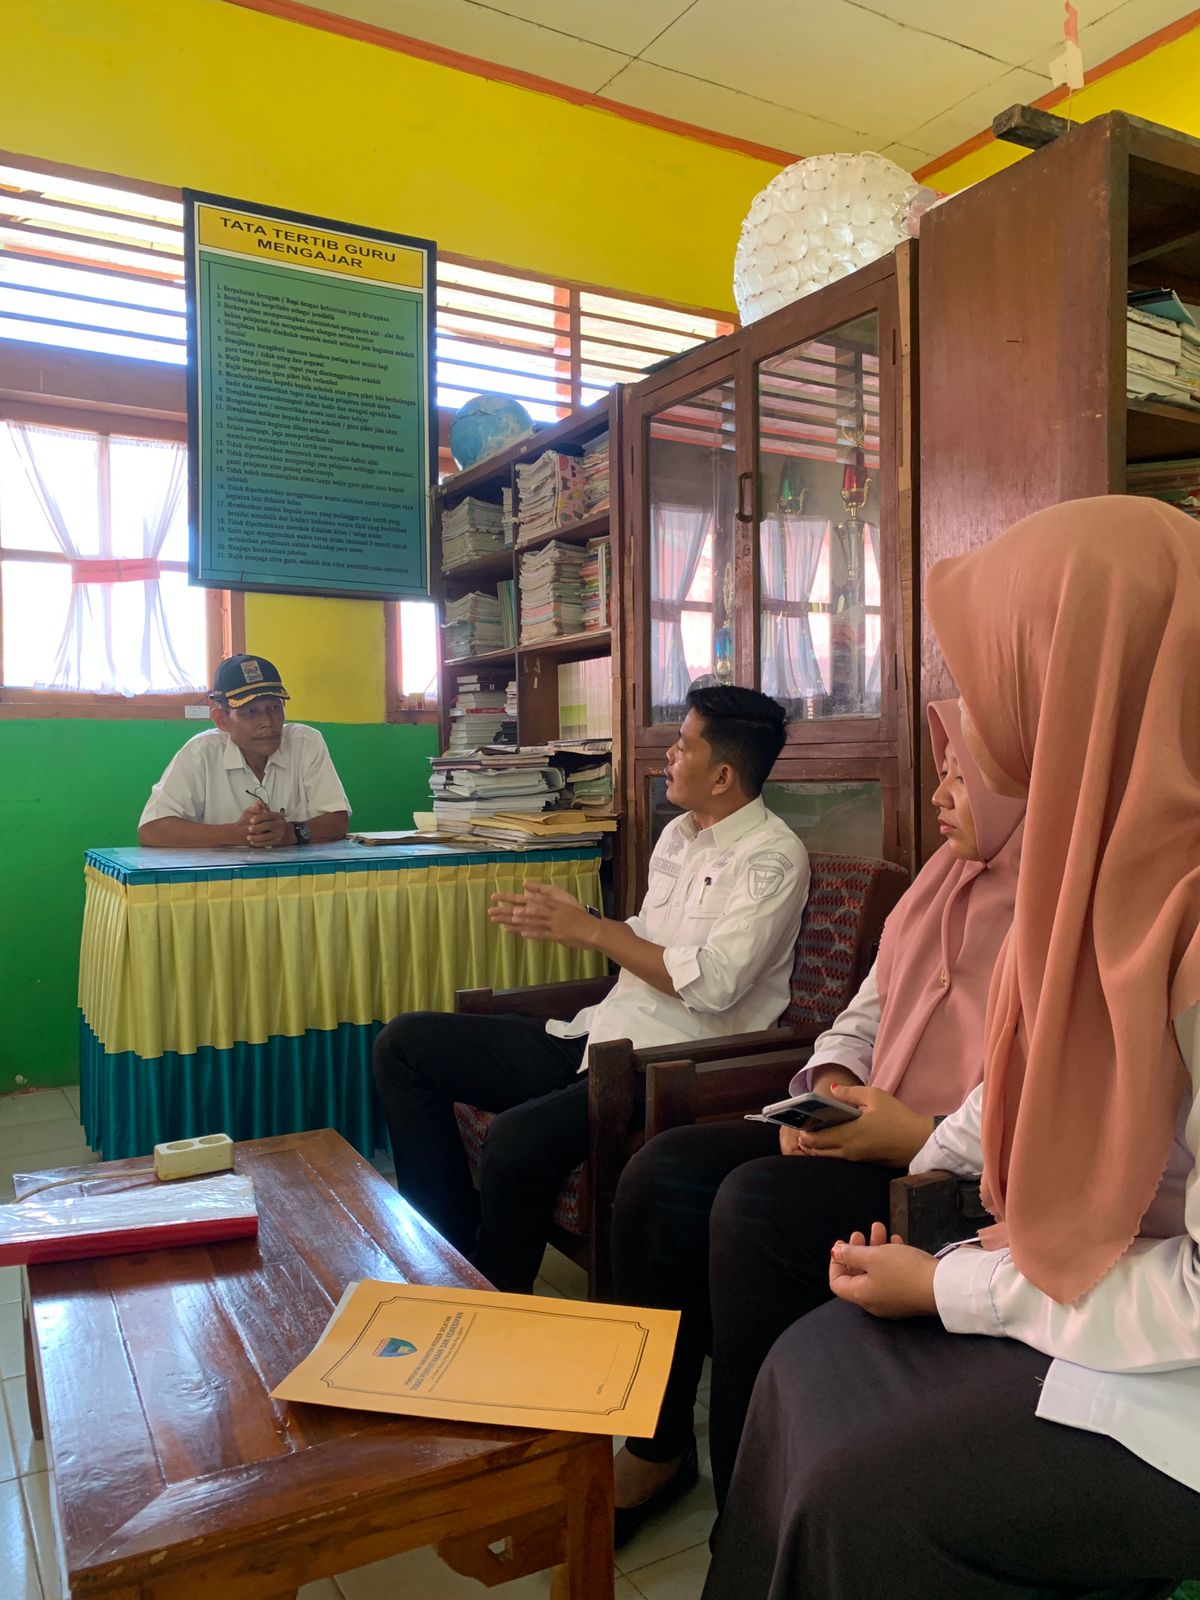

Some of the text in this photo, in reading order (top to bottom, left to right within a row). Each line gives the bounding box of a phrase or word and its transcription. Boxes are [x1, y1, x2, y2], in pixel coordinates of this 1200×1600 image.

[220, 216, 397, 263] TATA TERTIB GURU
[257, 238, 363, 269] MENGAJAR
